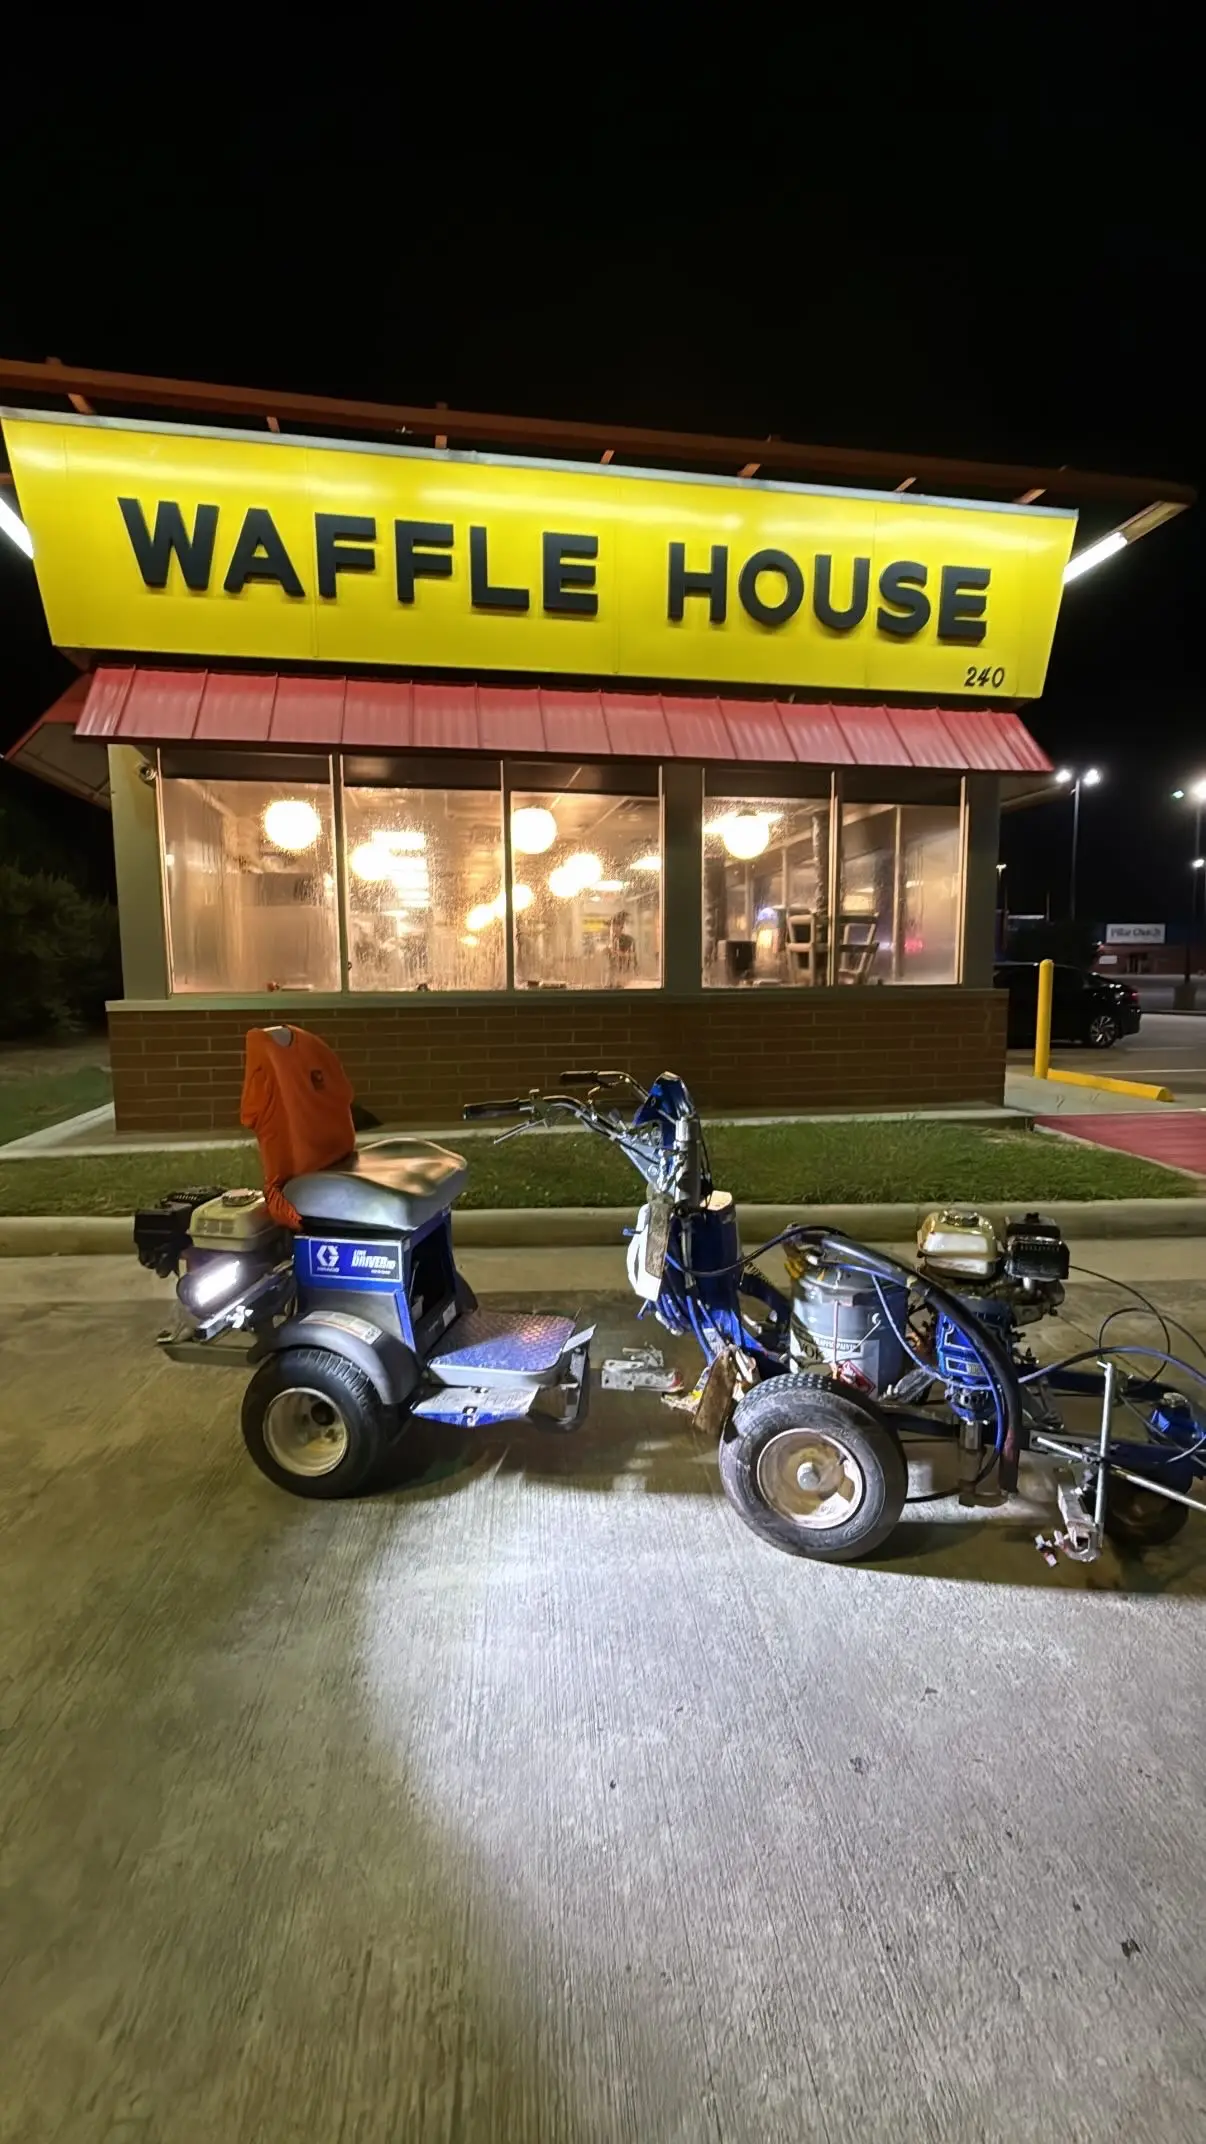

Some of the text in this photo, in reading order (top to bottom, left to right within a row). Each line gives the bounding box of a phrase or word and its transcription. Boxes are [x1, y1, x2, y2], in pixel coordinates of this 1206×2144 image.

[117, 497, 992, 644] WAFFLE HOUSE
[964, 666, 1005, 688] 240
